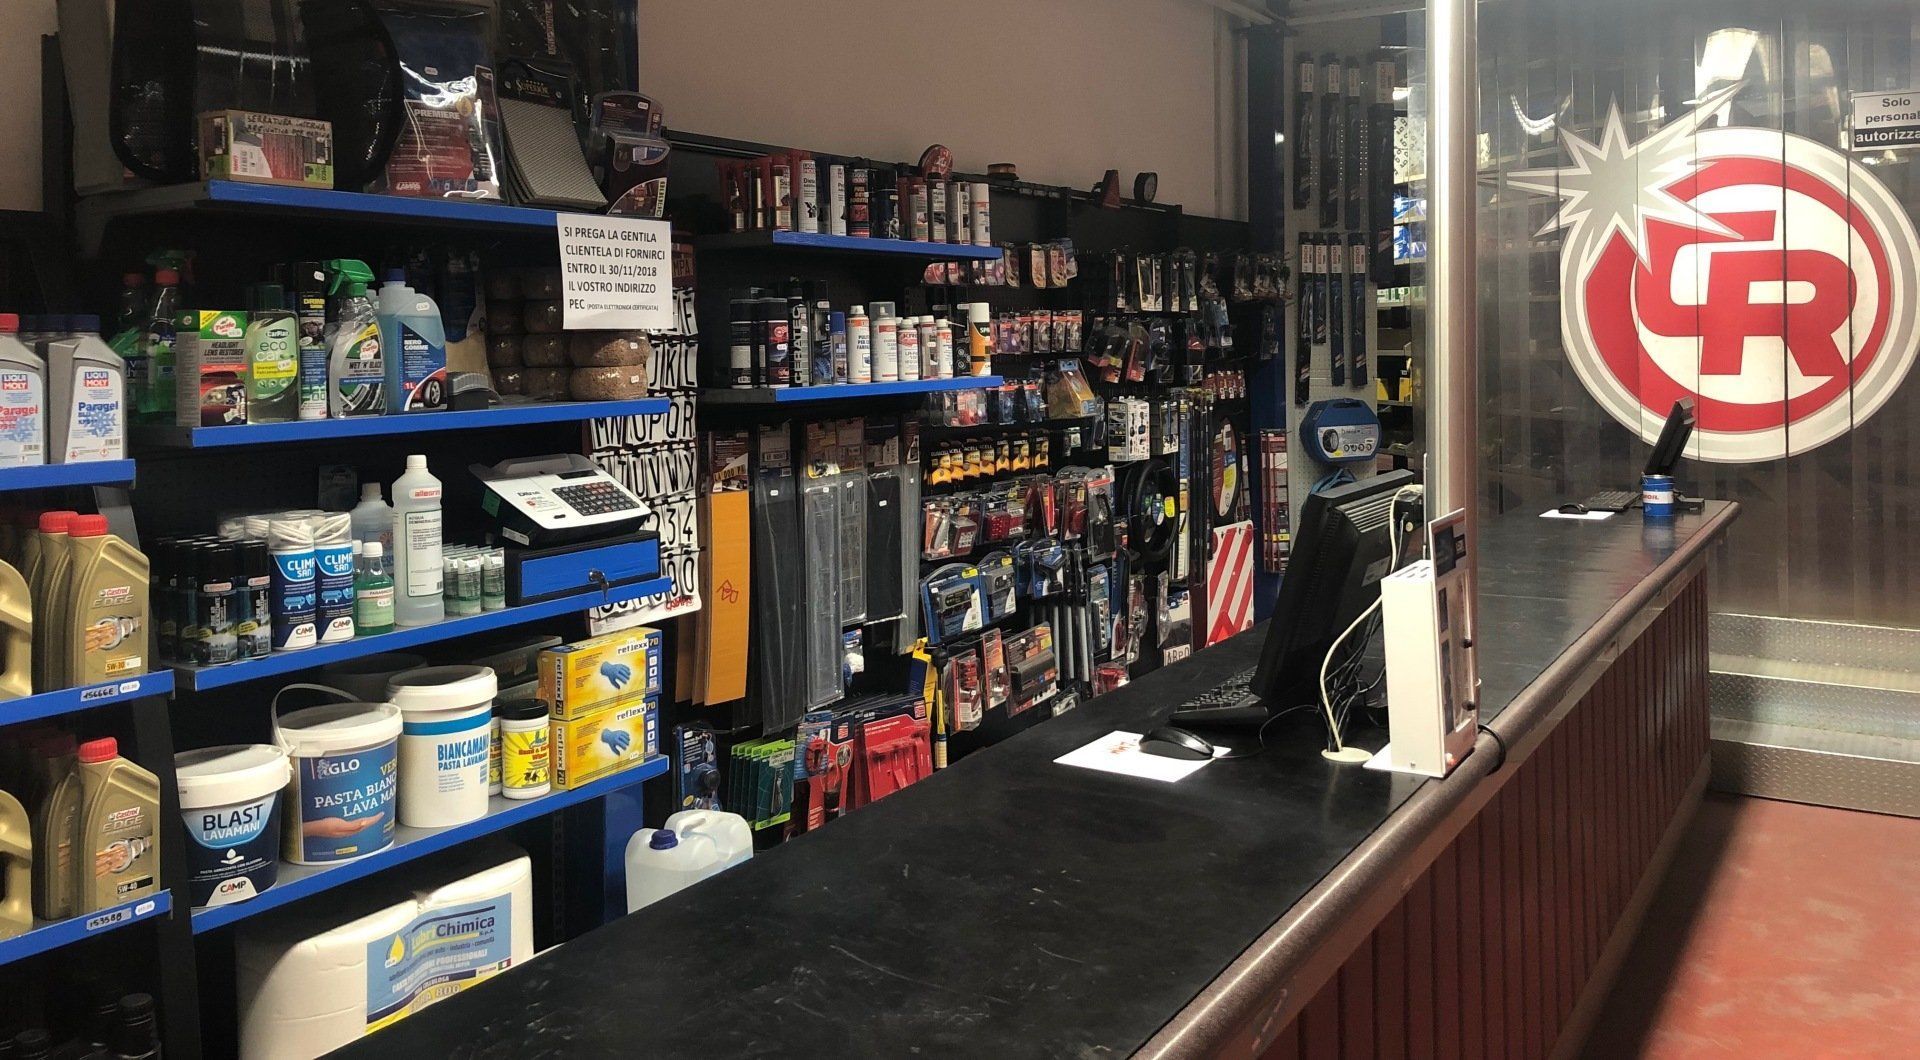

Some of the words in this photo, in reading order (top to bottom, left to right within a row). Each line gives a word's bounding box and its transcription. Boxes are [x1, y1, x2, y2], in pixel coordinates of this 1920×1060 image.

[1882, 97, 1911, 107] Solo
[414, 108, 460, 120] PREMIERE
[564, 226, 573, 237] SI
[575, 227, 606, 239] PREGA
[608, 230, 619, 240] LA
[621, 231, 657, 243] GENTILA
[565, 244, 612, 257] CLIENTELA
[614, 248, 623, 258] DI
[625, 248, 665, 261] FORNIRCI
[567, 262, 597, 274] ENTRO
[599, 264, 607, 275] IL
[608, 264, 657, 278] 30/11/2018
[568, 281, 576, 292] IL
[576, 281, 613, 293] VOSTRO
[614, 283, 656, 294] INDIRIZZO
[569, 298, 585, 310] PEC
[260, 341, 287, 352] eco
[792, 304, 802, 384] CERATEC
[3, 374, 28, 383] LIQUI
[86, 371, 109, 380] LIQUI
[78, 401, 119, 412] Paragel
[297, 569, 312, 578] SAN
[334, 564, 349, 573] SAN
[106, 587, 128, 597] Castrol
[92, 594, 134, 609] EDGE
[333, 619, 351, 628] CAMP
[296, 627, 314, 636] CAMP
[617, 640, 649, 656] reflexx
[649, 637, 659, 647] 70
[107, 662, 125, 672] 5W-30
[556, 700, 564, 715] 70
[616, 704, 645, 720] reflexx
[646, 701, 656, 711] 70
[438, 759, 461, 772] PASTA
[557, 770, 565, 784] 70
[314, 789, 363, 808] PASTA
[116, 808, 139, 819] Castrol
[343, 798, 379, 817] LAVA
[103, 815, 145, 832] EDGE
[203, 804, 264, 831] BLAST
[203, 820, 261, 841] LAVAMANI
[118, 882, 137, 894] 5W-40
[220, 880, 247, 893] CAMP
